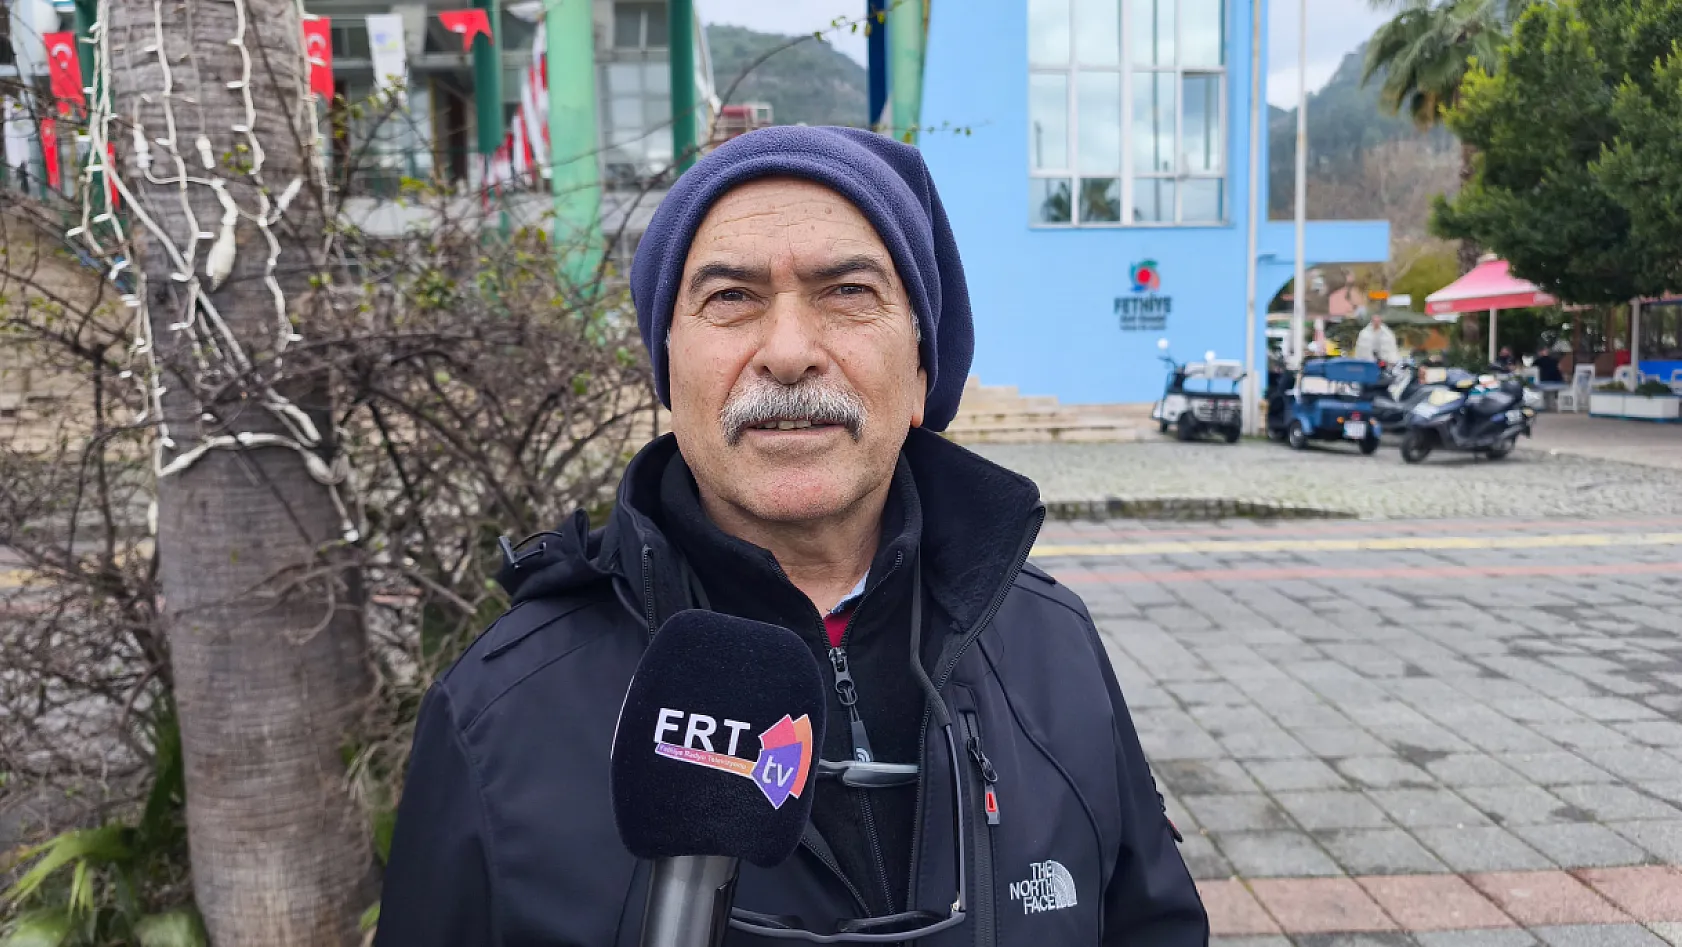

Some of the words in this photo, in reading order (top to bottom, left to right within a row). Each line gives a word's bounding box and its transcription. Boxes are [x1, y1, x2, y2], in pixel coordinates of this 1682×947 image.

[654, 708, 751, 756] FRT
[762, 755, 793, 787] tv
[1030, 860, 1052, 881] THE
[1010, 878, 1053, 900] NORTH
[1023, 895, 1055, 915] FACE
